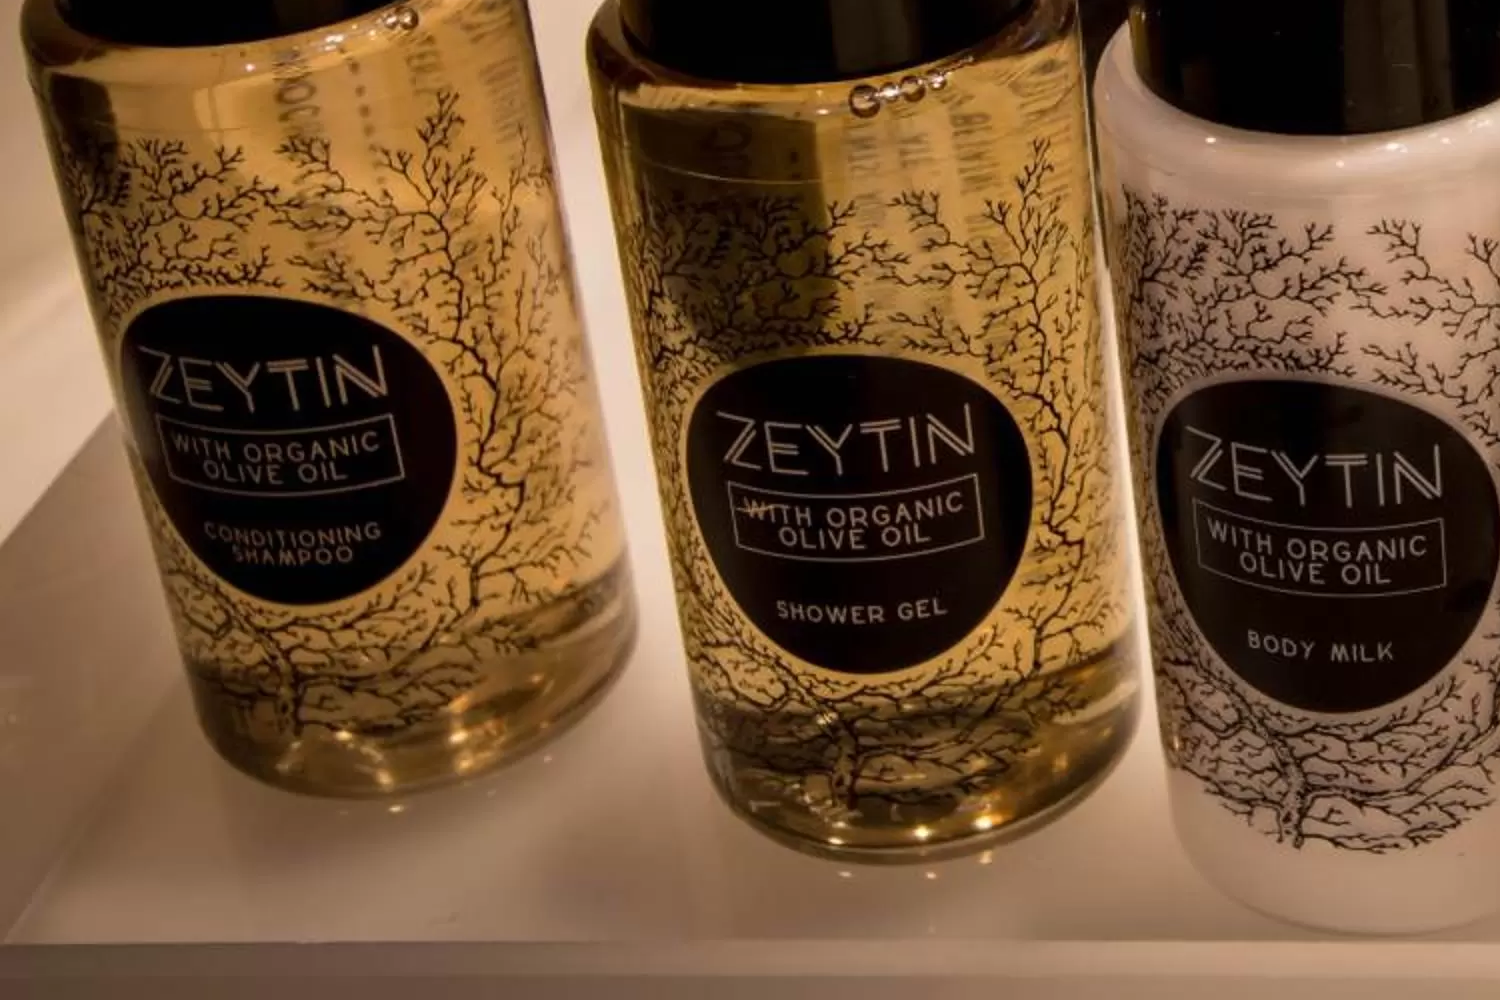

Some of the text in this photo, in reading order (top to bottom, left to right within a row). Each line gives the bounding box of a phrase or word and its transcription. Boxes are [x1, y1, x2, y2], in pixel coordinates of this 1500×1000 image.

[138, 343, 390, 414] ZEYTIN
[171, 430, 381, 463] WITH ORGANIC
[715, 402, 976, 477] ZEYTIN
[202, 459, 348, 485] OLIVE OIL
[1184, 424, 1444, 508] ZEYTIN
[741, 490, 965, 530] WITH ORGANIC
[202, 520, 382, 550] CONDITIONING
[778, 522, 932, 550] OLIVE OIL
[1206, 516, 1428, 564] WITH ORGANIC
[231, 544, 354, 567] SHAMPOO
[1238, 551, 1392, 586] OLIVE OIL
[775, 597, 950, 625] SHOWER GEL
[1246, 628, 1395, 664] BODY MILK
